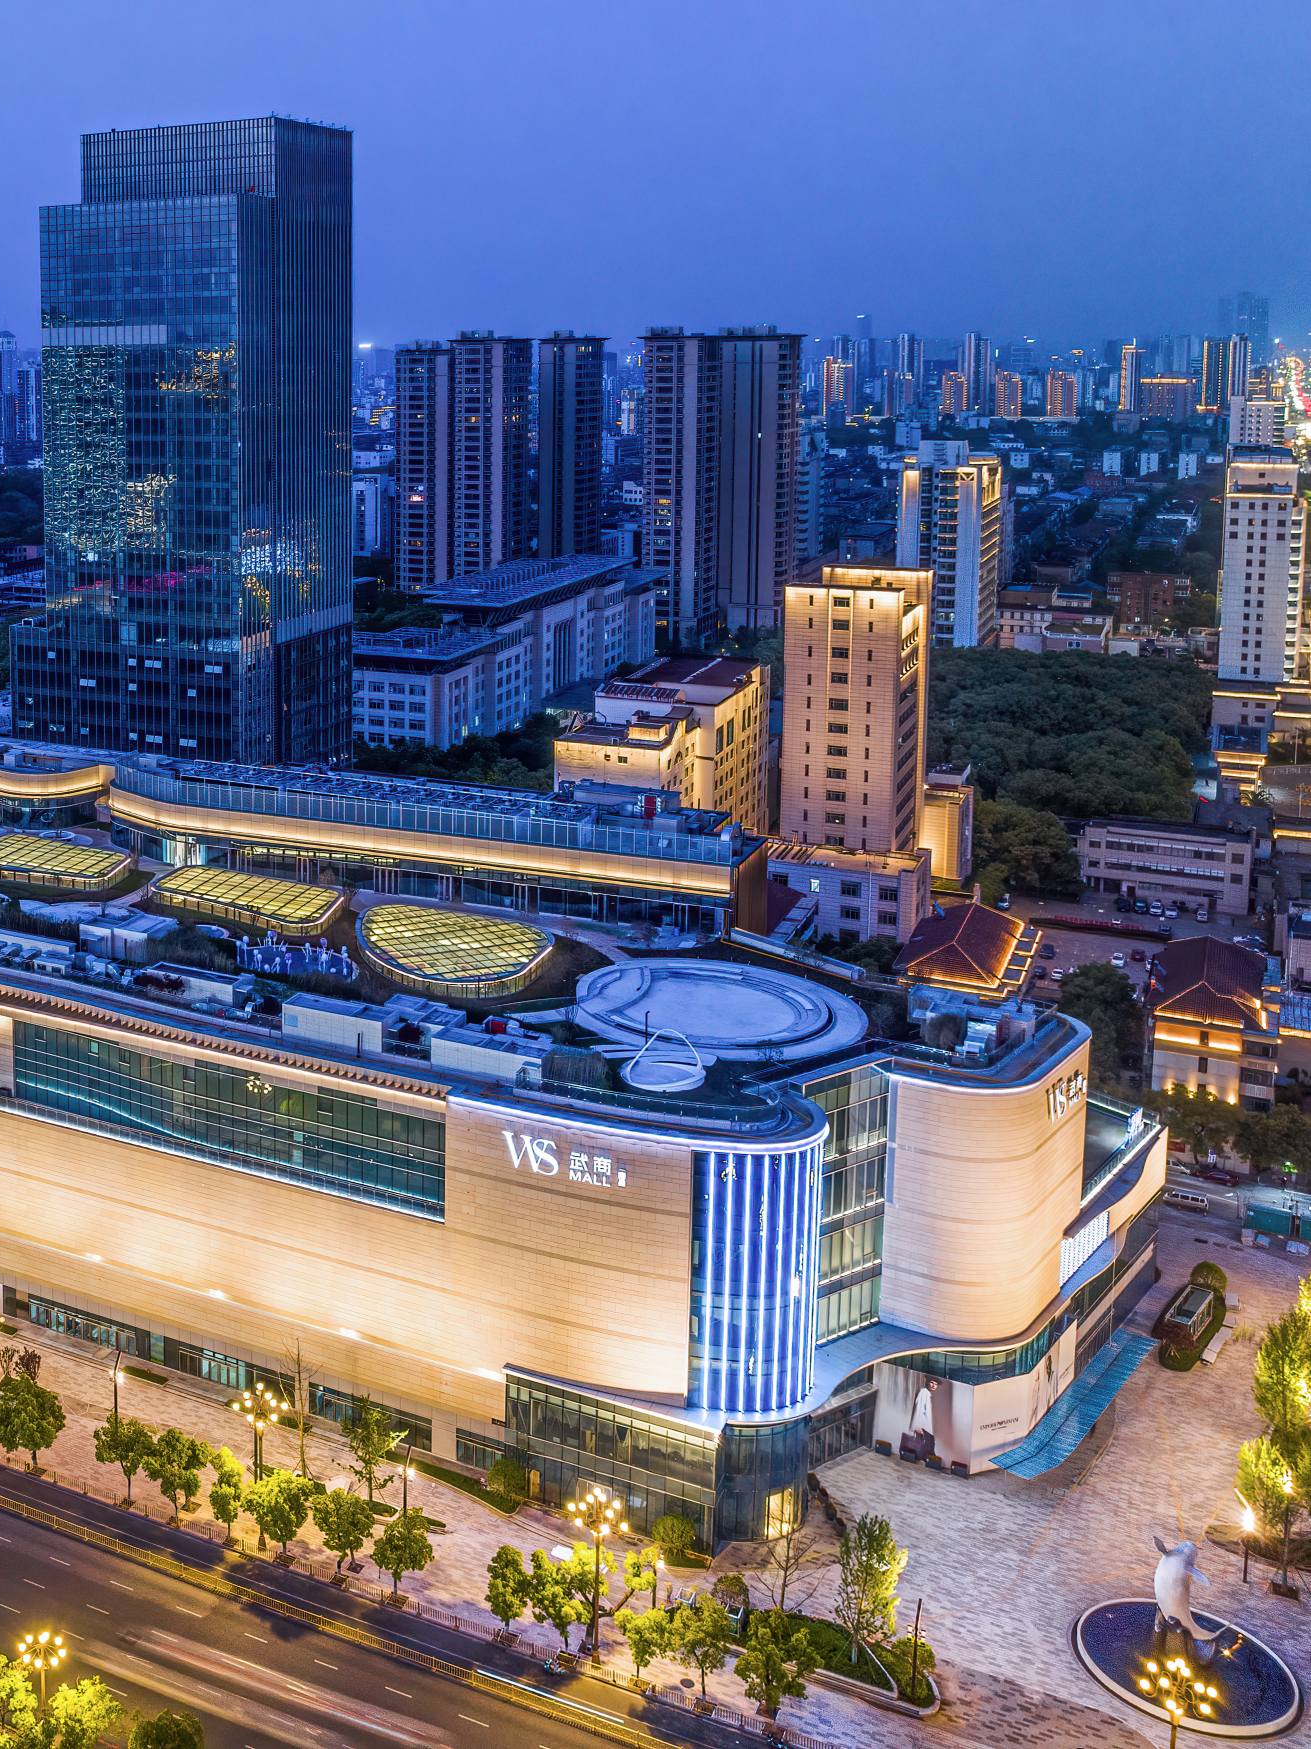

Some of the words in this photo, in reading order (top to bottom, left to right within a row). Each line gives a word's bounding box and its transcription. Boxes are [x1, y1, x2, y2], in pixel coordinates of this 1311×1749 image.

[501, 1130, 559, 1176] WS
[569, 1151, 612, 1176] 武商
[569, 1169, 611, 1188] MALL
